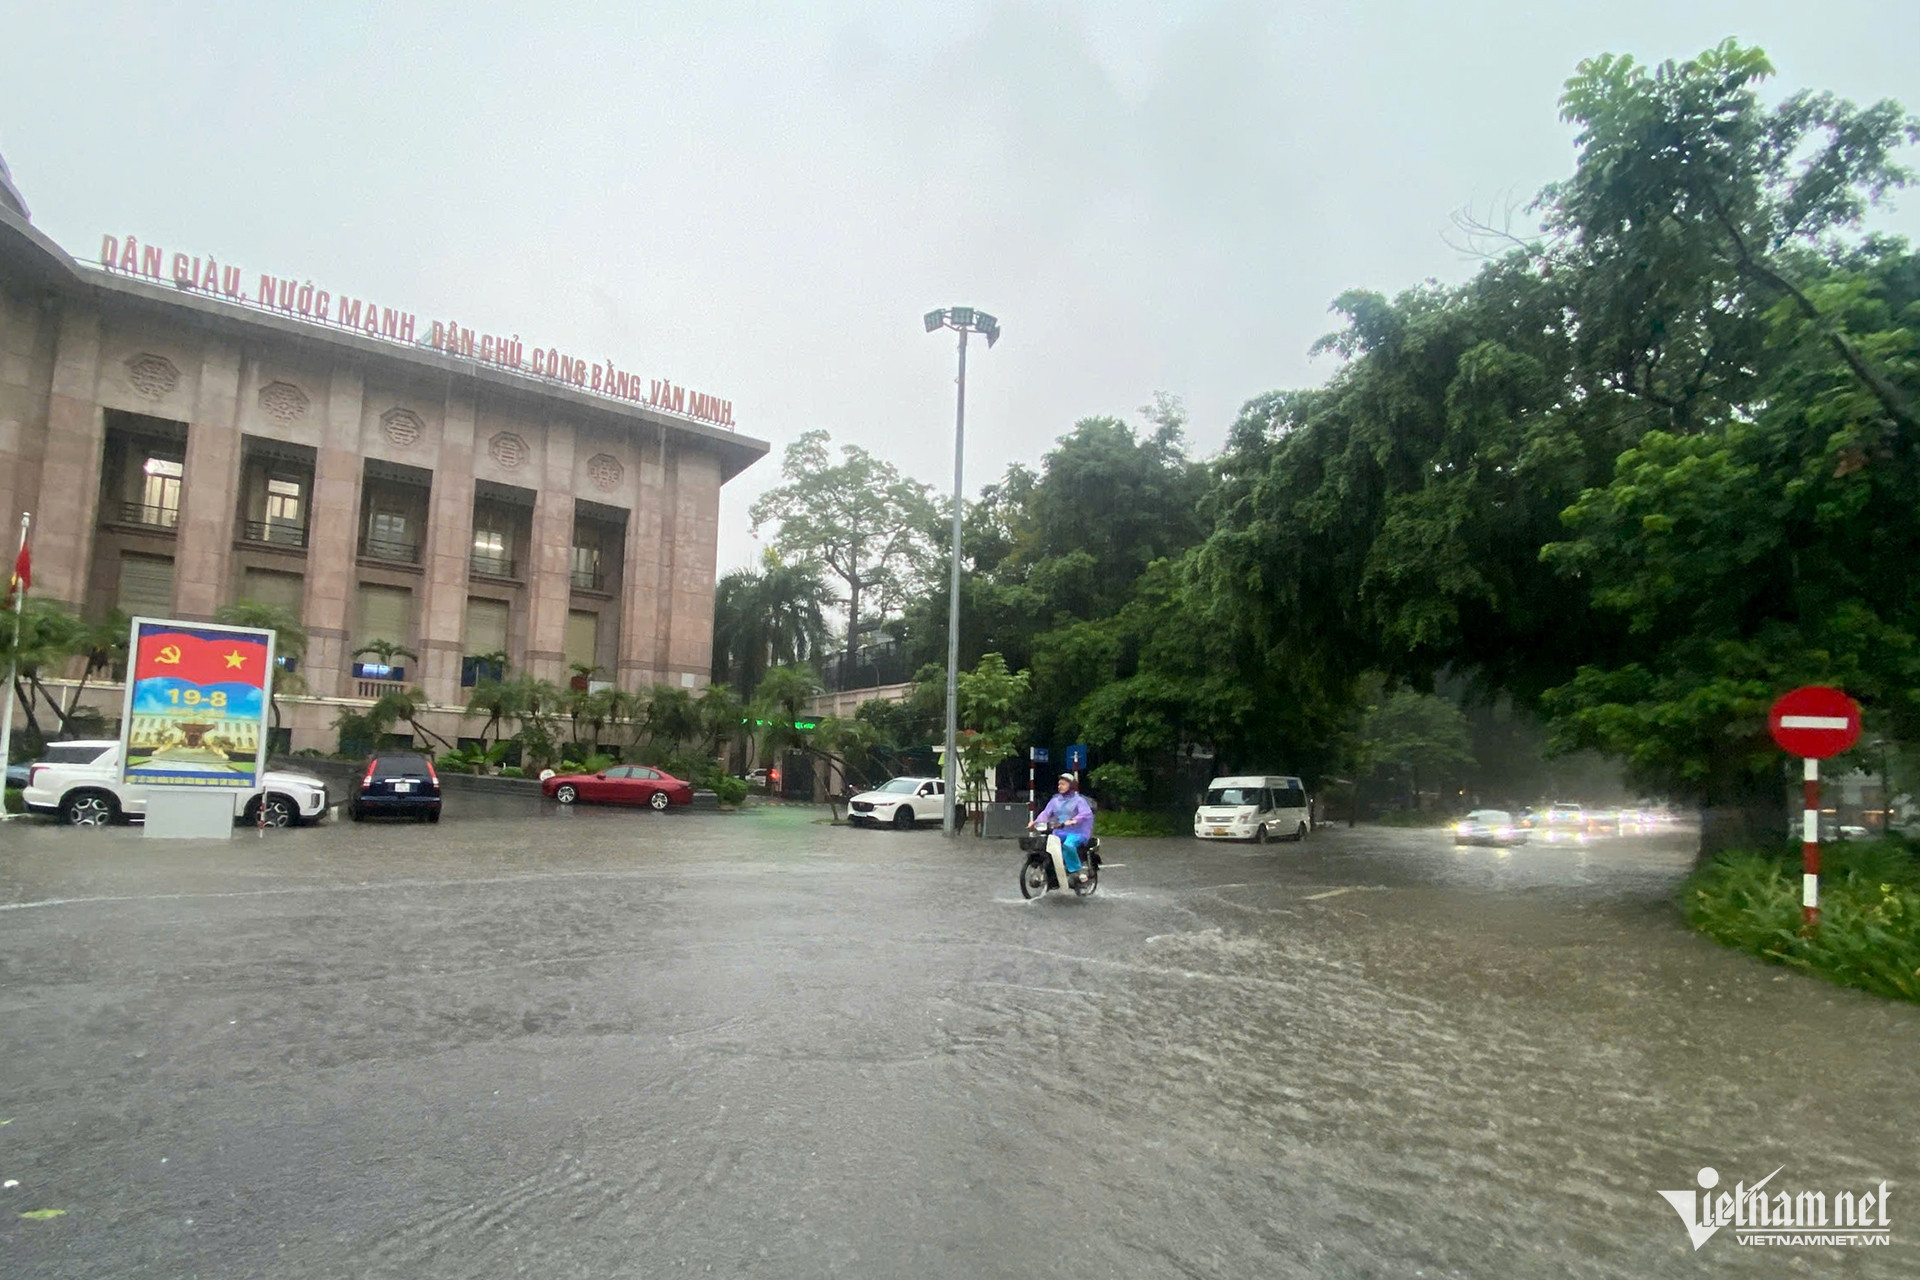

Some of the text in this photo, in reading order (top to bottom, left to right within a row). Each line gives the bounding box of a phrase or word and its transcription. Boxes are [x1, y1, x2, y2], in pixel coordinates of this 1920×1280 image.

[101, 234, 162, 278] DÂN
[259, 274, 331, 319] NƯỚC
[431, 320, 475, 357] DÂN
[650, 378, 685, 412] VĂN
[169, 688, 227, 707] 19-8
